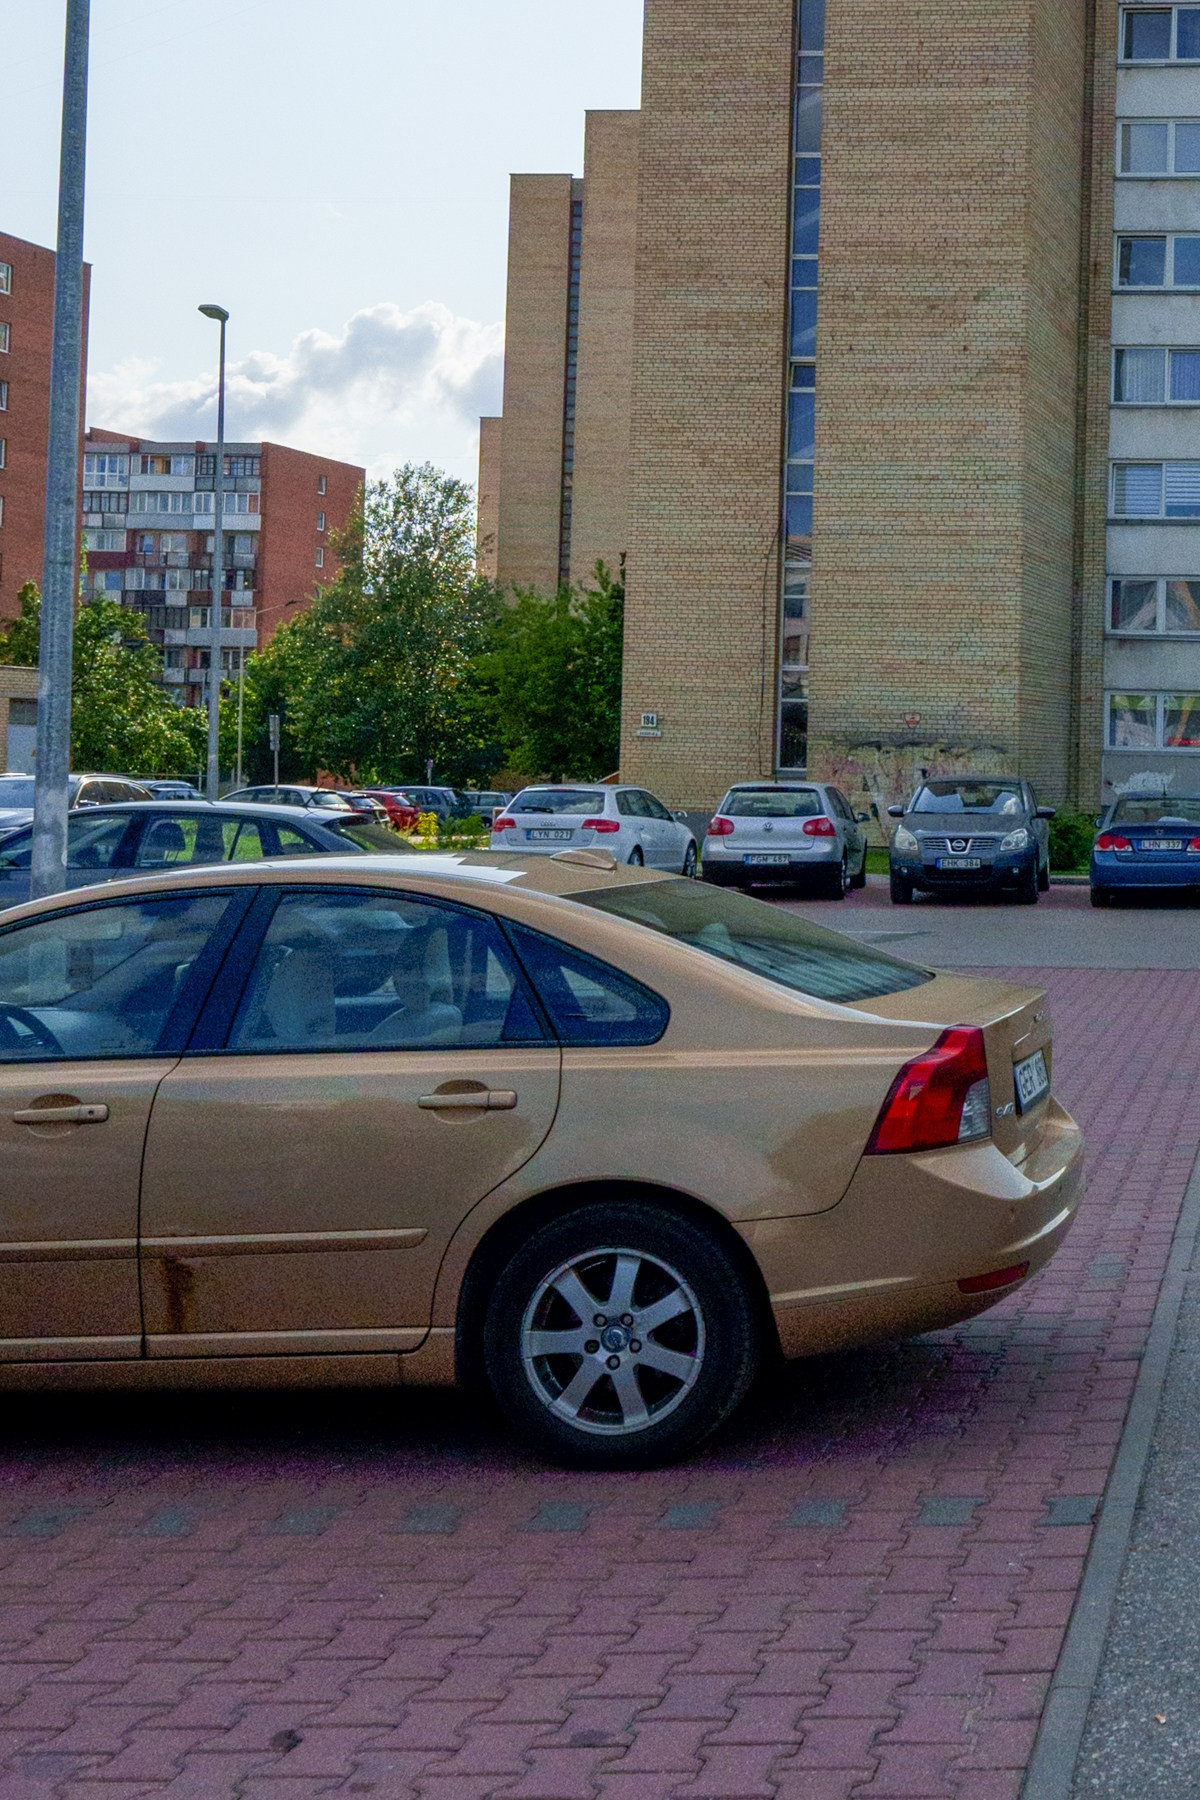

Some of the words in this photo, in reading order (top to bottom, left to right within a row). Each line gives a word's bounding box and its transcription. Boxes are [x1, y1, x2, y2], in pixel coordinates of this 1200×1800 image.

[750, 855, 769, 863] FGM
[941, 859, 959, 867] EHK
[1020, 1062, 1036, 1099] GER
